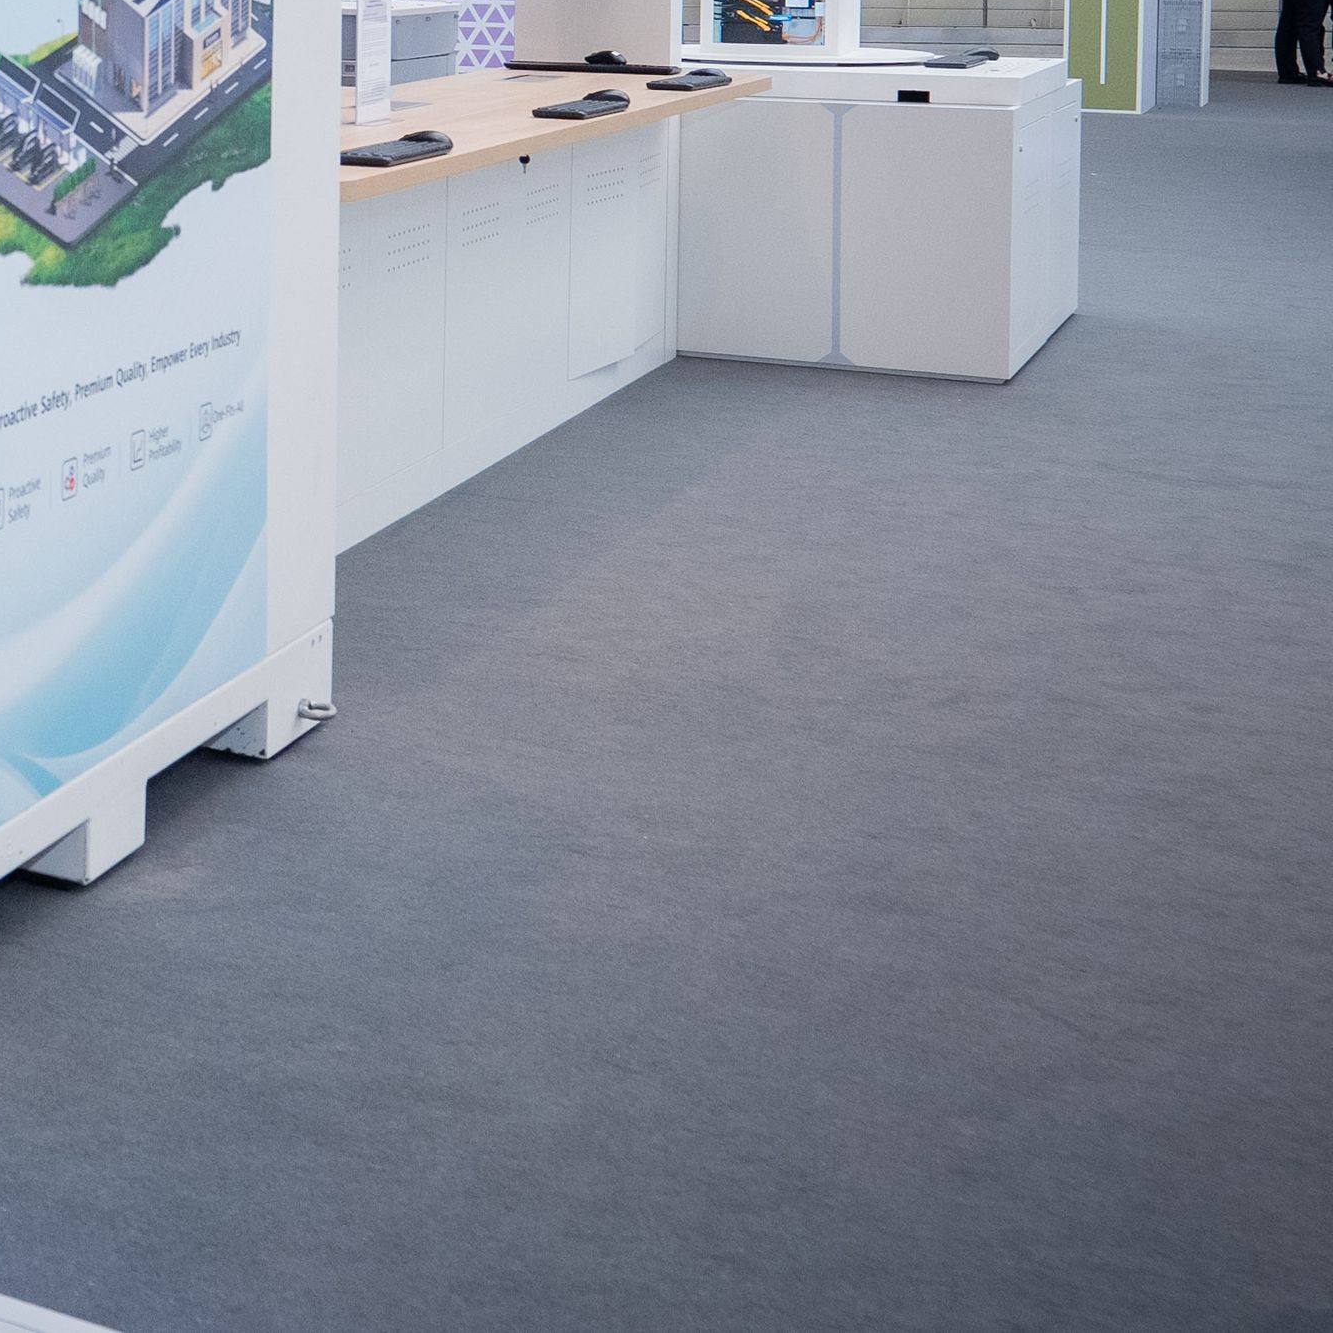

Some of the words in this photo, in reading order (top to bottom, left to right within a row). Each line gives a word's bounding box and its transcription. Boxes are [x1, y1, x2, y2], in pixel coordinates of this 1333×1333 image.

[41, 389, 72, 415] Safety,
[74, 374, 114, 402] Premium
[116, 361, 148, 387] Quality,
[151, 348, 188, 372] Empower
[189, 339, 209, 359] Every
[211, 330, 242, 353] Industry
[149, 427, 169, 444] Higher
[83, 446, 112, 466] Premium
[8, 477, 41, 500] Proactive
[83, 469, 105, 488] Quality
[8, 504, 31, 524] Safety
